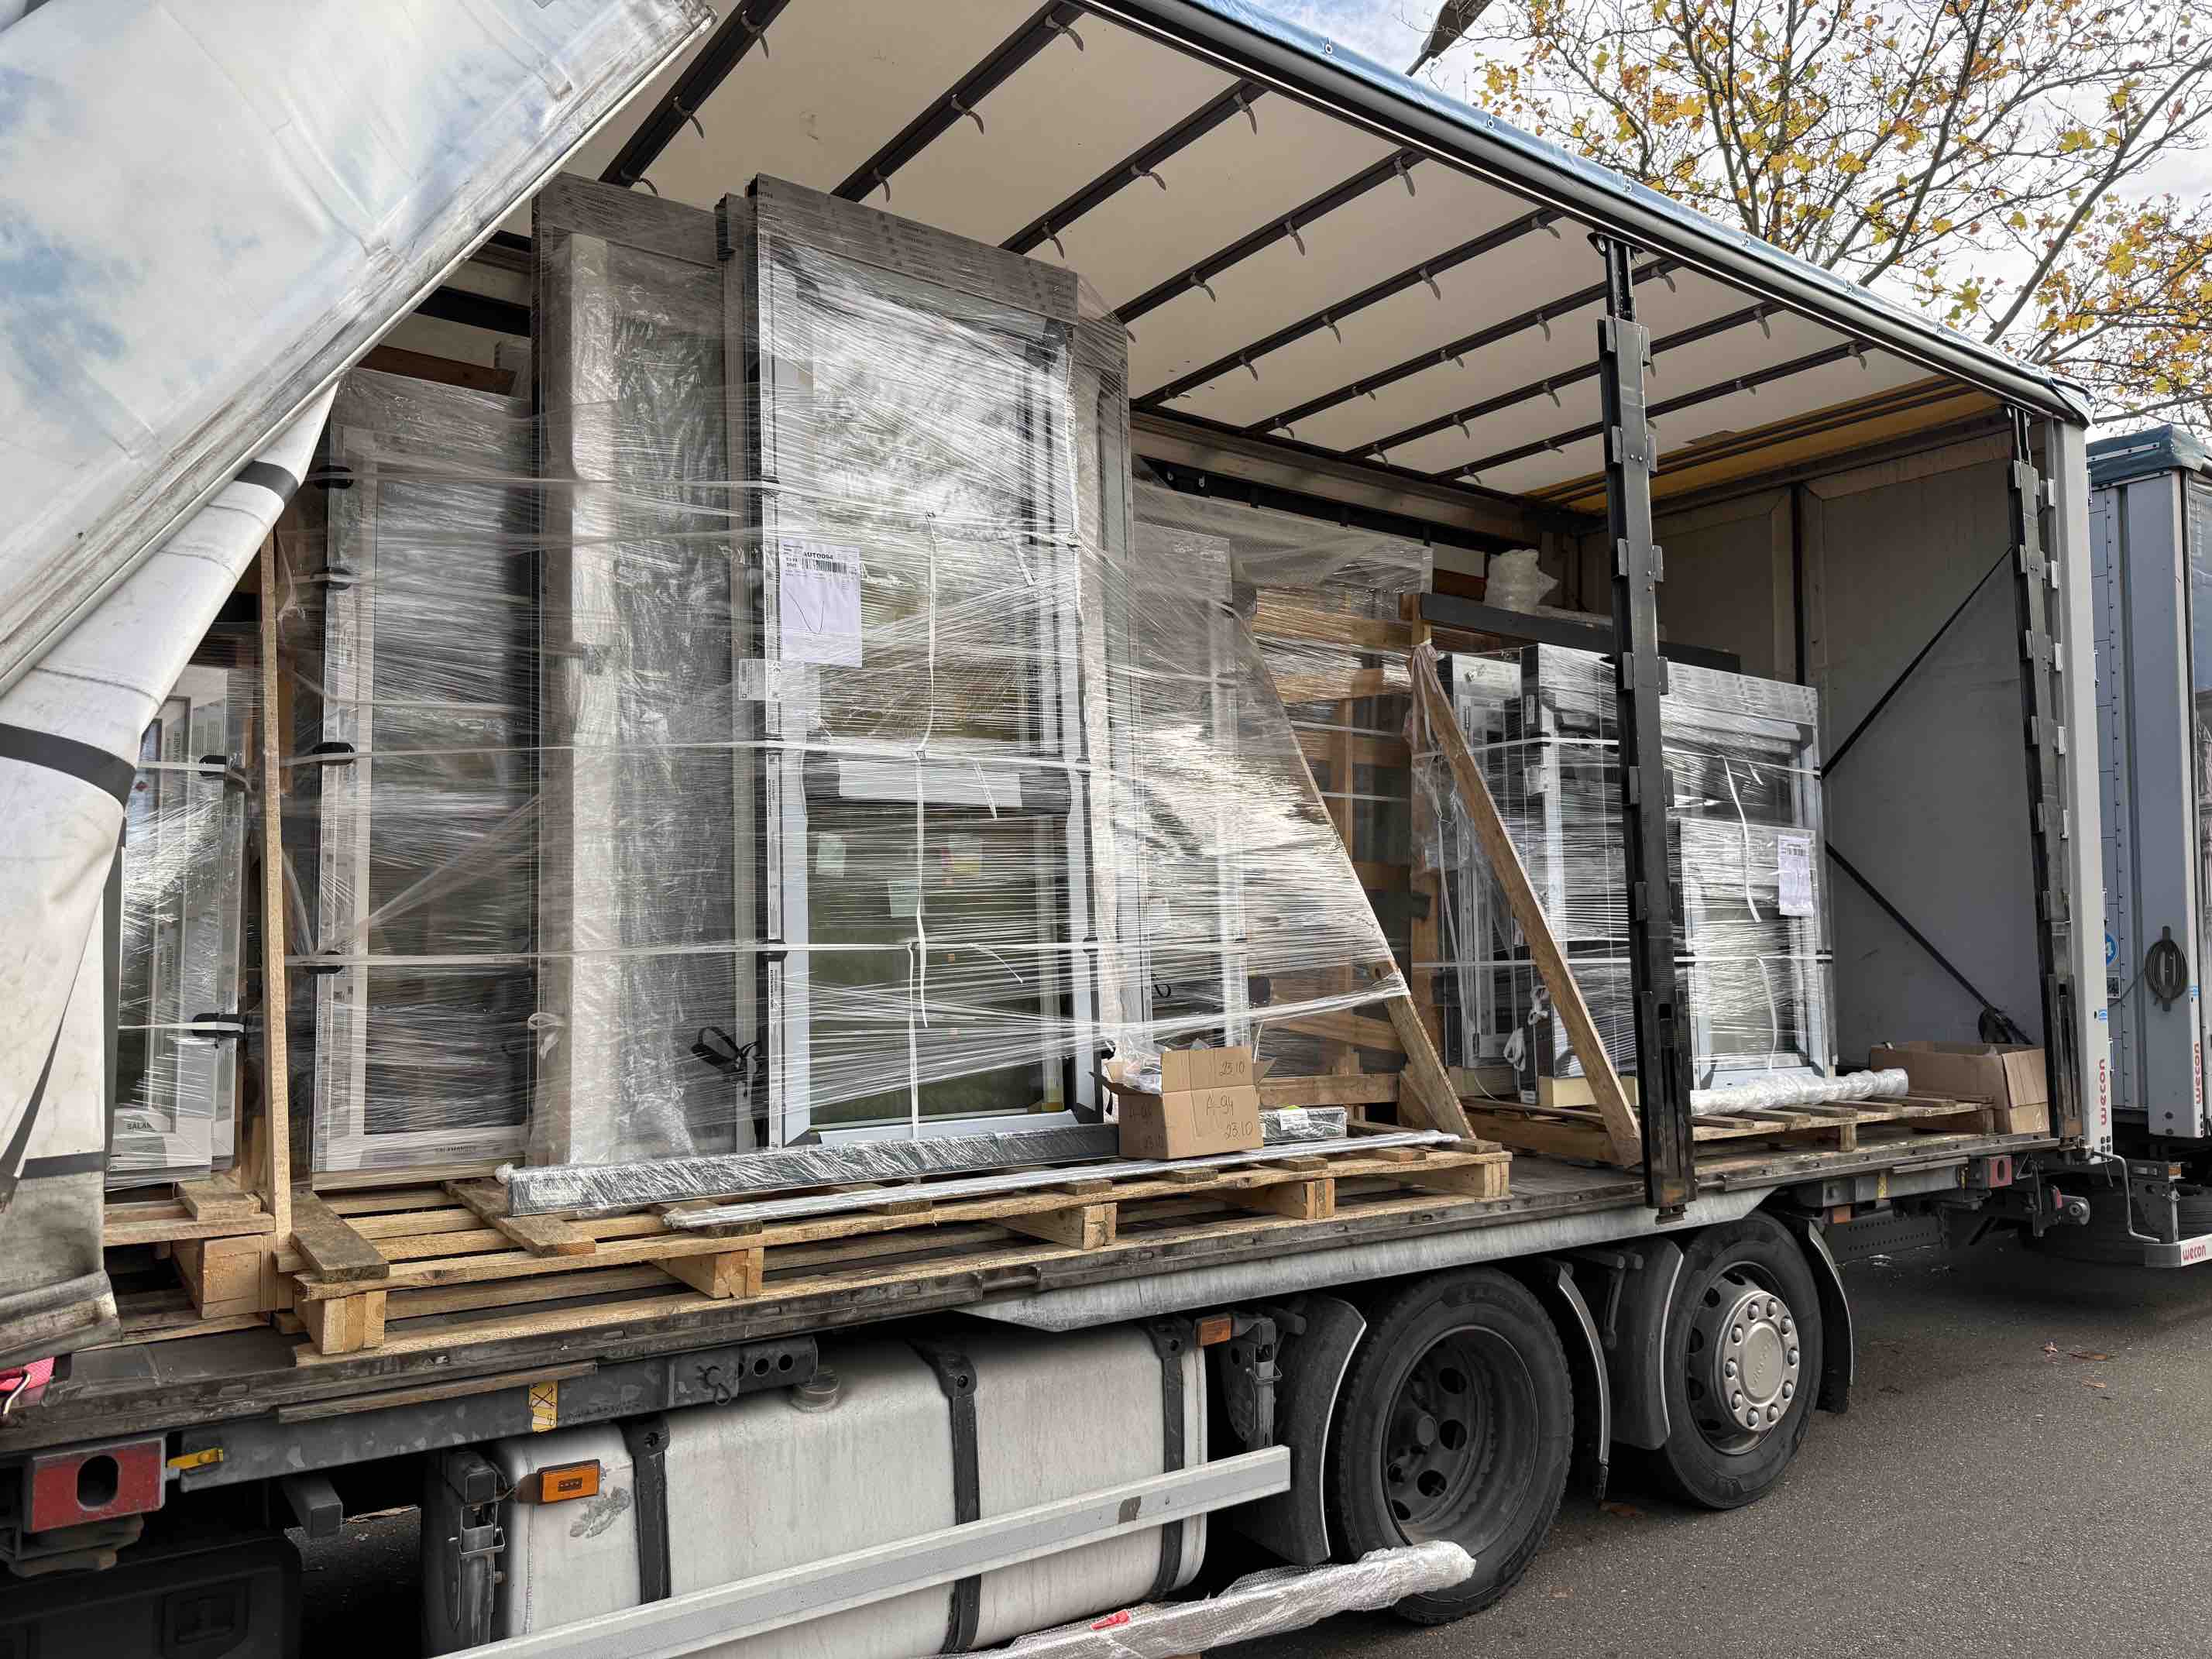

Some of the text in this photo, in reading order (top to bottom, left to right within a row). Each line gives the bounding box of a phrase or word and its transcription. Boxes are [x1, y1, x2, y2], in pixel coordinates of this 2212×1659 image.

[2098, 1058, 2107, 1126] wecon
[2193, 1042, 2202, 1105] wecon
[2183, 1245, 2207, 1261] wecon
